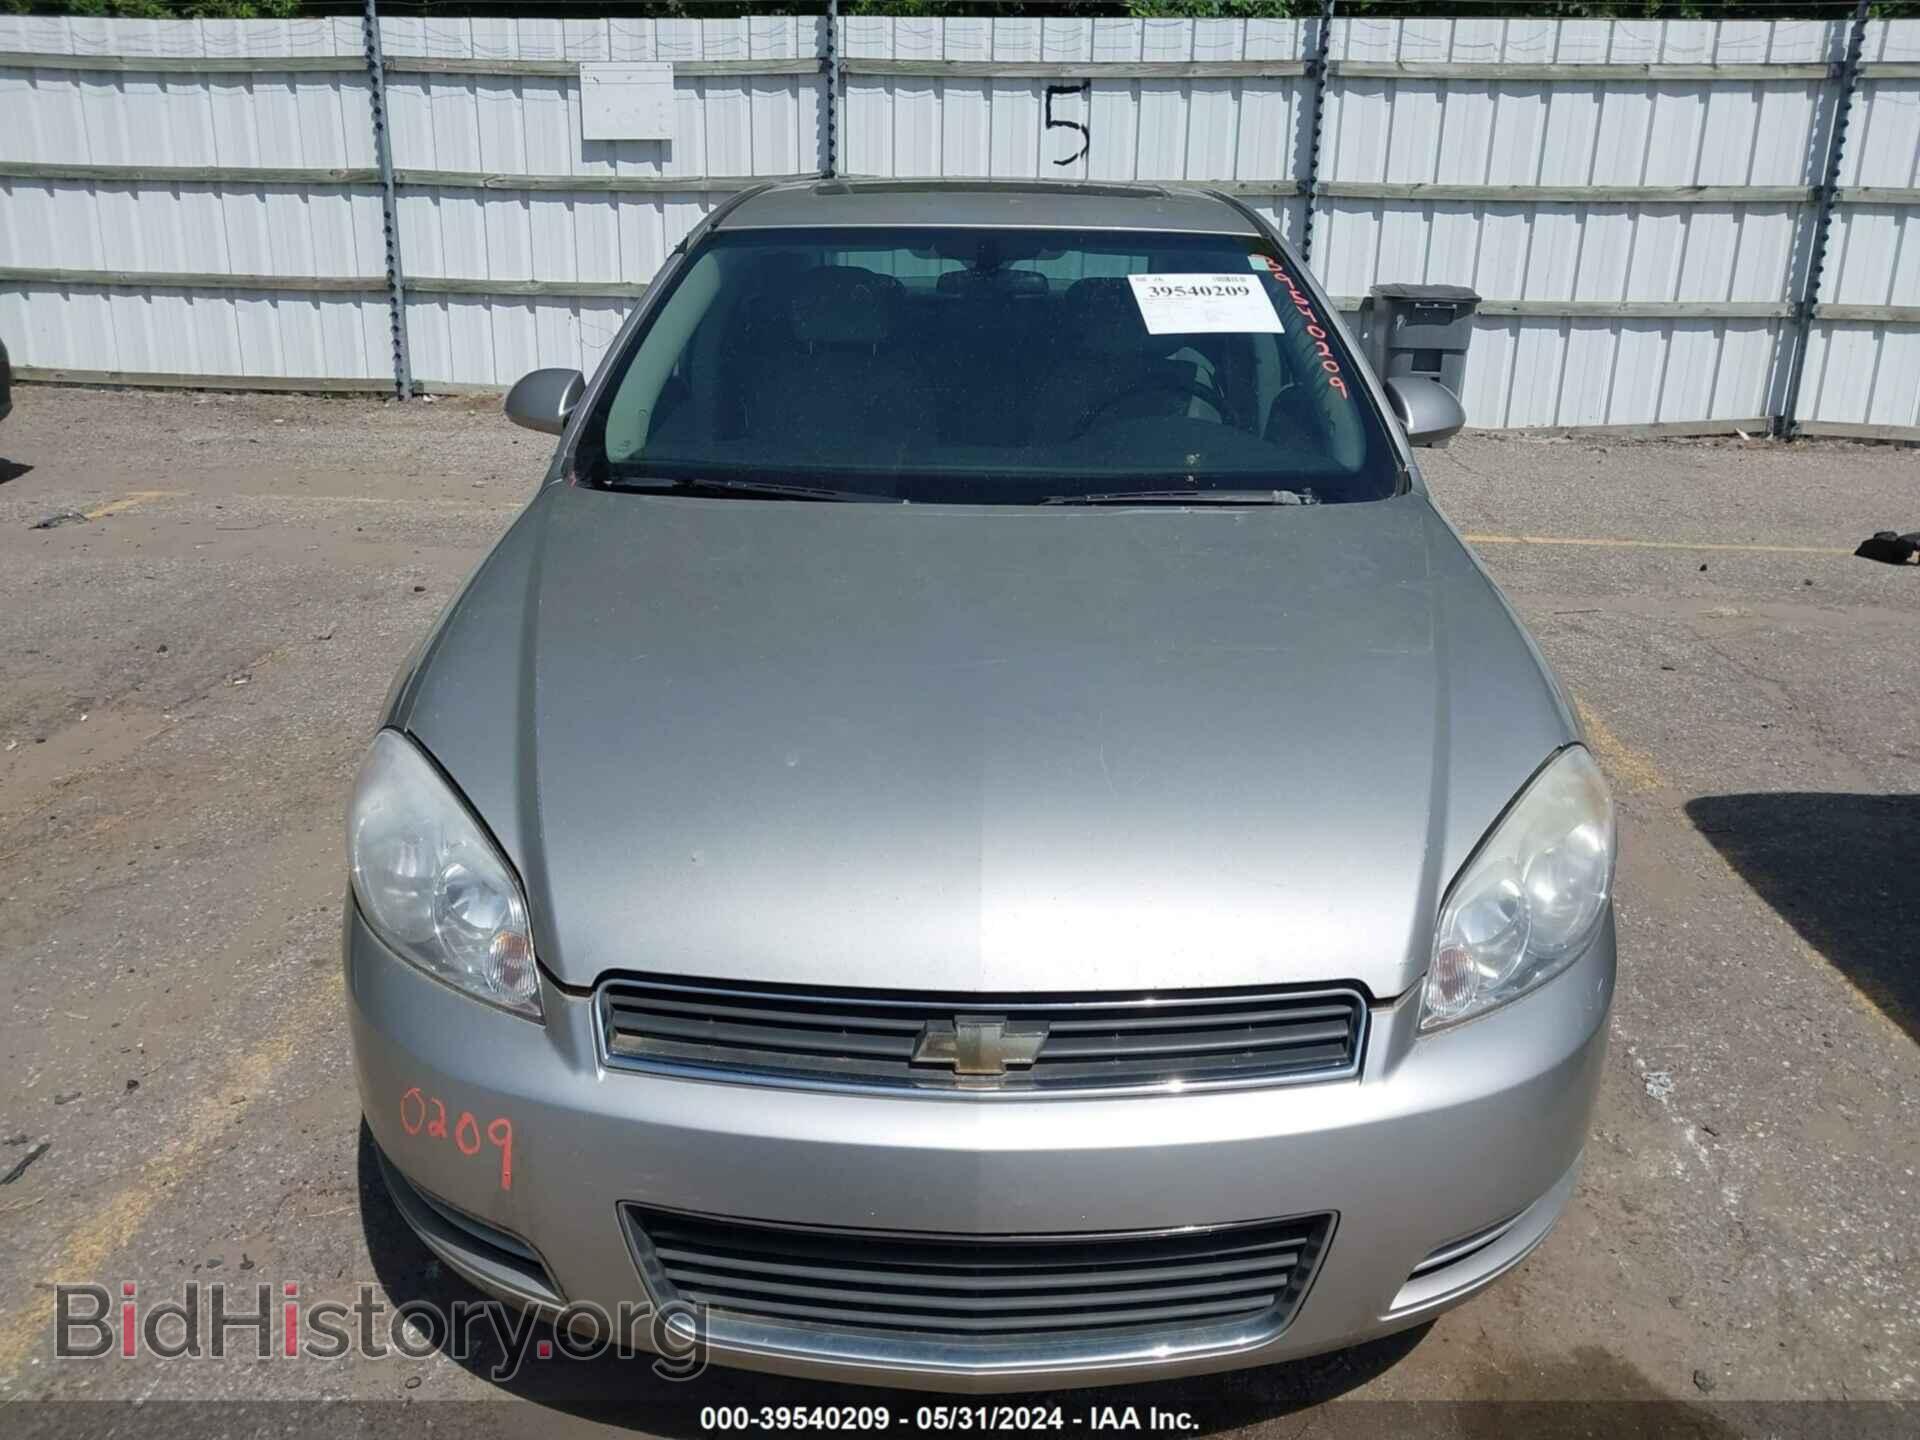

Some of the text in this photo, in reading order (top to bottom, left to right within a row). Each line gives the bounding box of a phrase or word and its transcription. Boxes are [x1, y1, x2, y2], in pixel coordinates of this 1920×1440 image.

[1045, 81, 1091, 166] 5
[1148, 285, 1250, 297] 39540209
[400, 1087, 512, 1190] 0209
